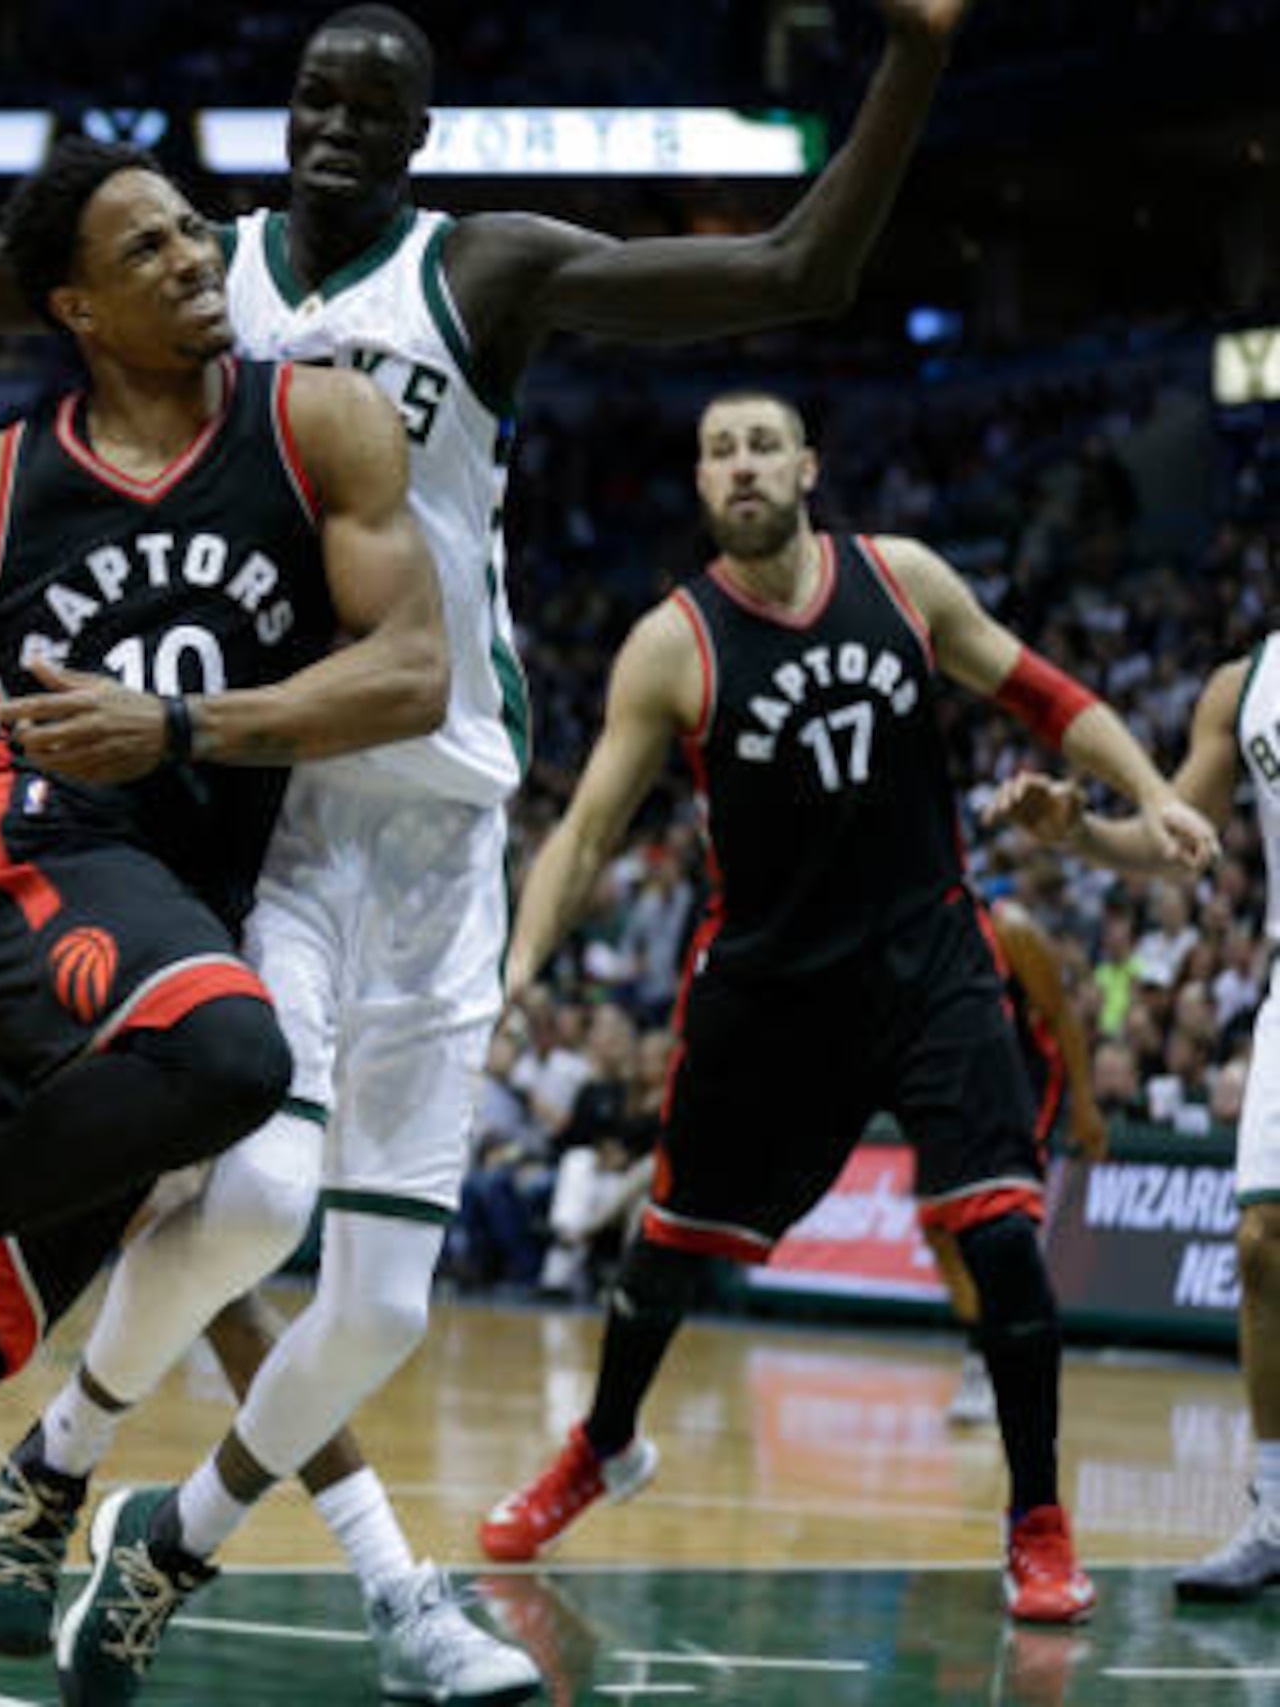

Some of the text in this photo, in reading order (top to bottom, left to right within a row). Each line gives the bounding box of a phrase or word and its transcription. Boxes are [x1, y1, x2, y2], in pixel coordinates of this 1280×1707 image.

[20, 532, 295, 675] RAPTORS
[103, 624, 227, 697] 10
[736, 641, 918, 762] RAPTORS
[799, 700, 874, 791] 17
[1173, 1243, 1243, 1308] NE
